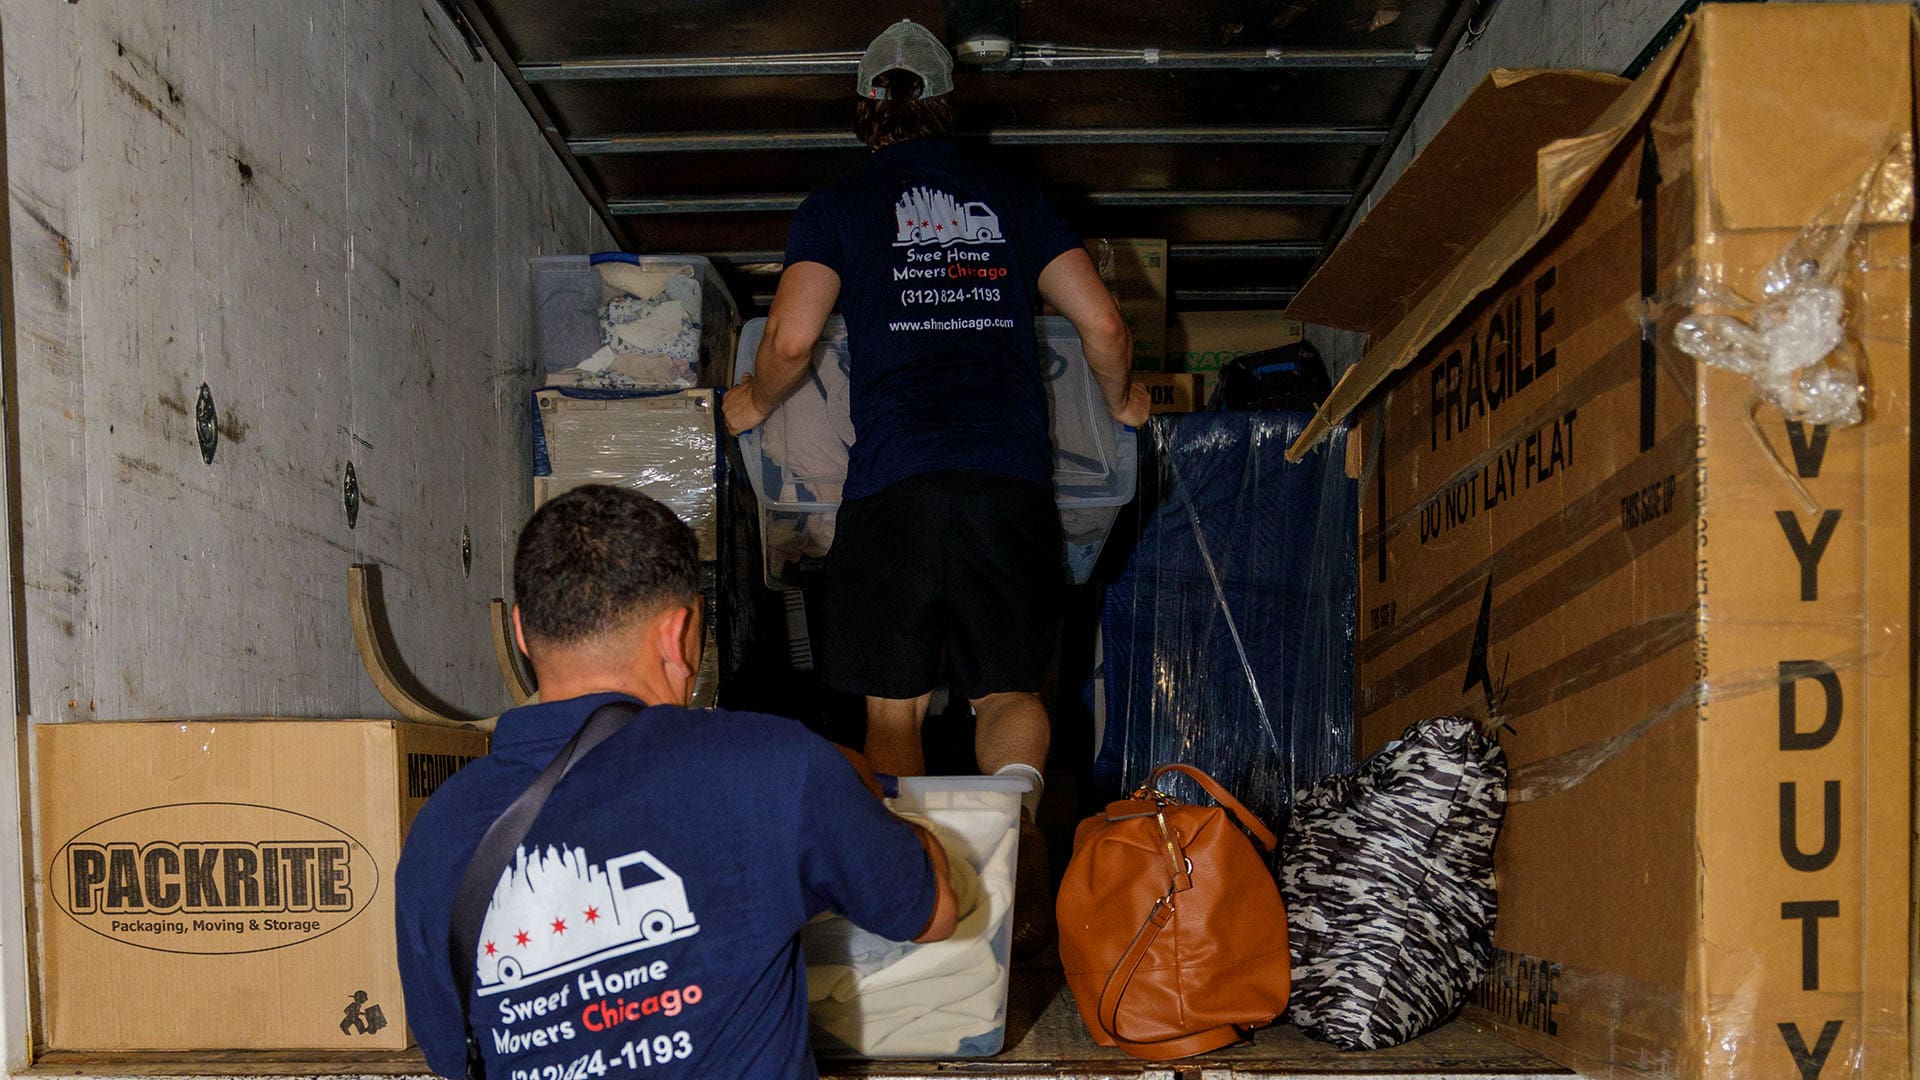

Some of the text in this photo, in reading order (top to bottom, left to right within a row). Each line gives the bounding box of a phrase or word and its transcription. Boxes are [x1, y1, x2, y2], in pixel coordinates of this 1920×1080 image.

[893, 266, 946, 281] Movers
[947, 247, 990, 262] Home
[901, 287, 1000, 306] (312)824-1193
[1431, 266, 1556, 452] FRAGILE
[1146, 385, 1175, 405] OX
[1420, 409, 1577, 545] DO NOT LAY FLAT
[1621, 474, 1676, 531] THIS SIDE UP
[68, 840, 353, 915] PACKRITE
[1777, 660, 1844, 1080] DUTY
[111, 919, 320, 933] Packaging, Moving & Storage
[492, 984, 703, 1055] Movers Chicago
[499, 960, 669, 1024] Sweet Home
[1516, 953, 1560, 1037] CARE
